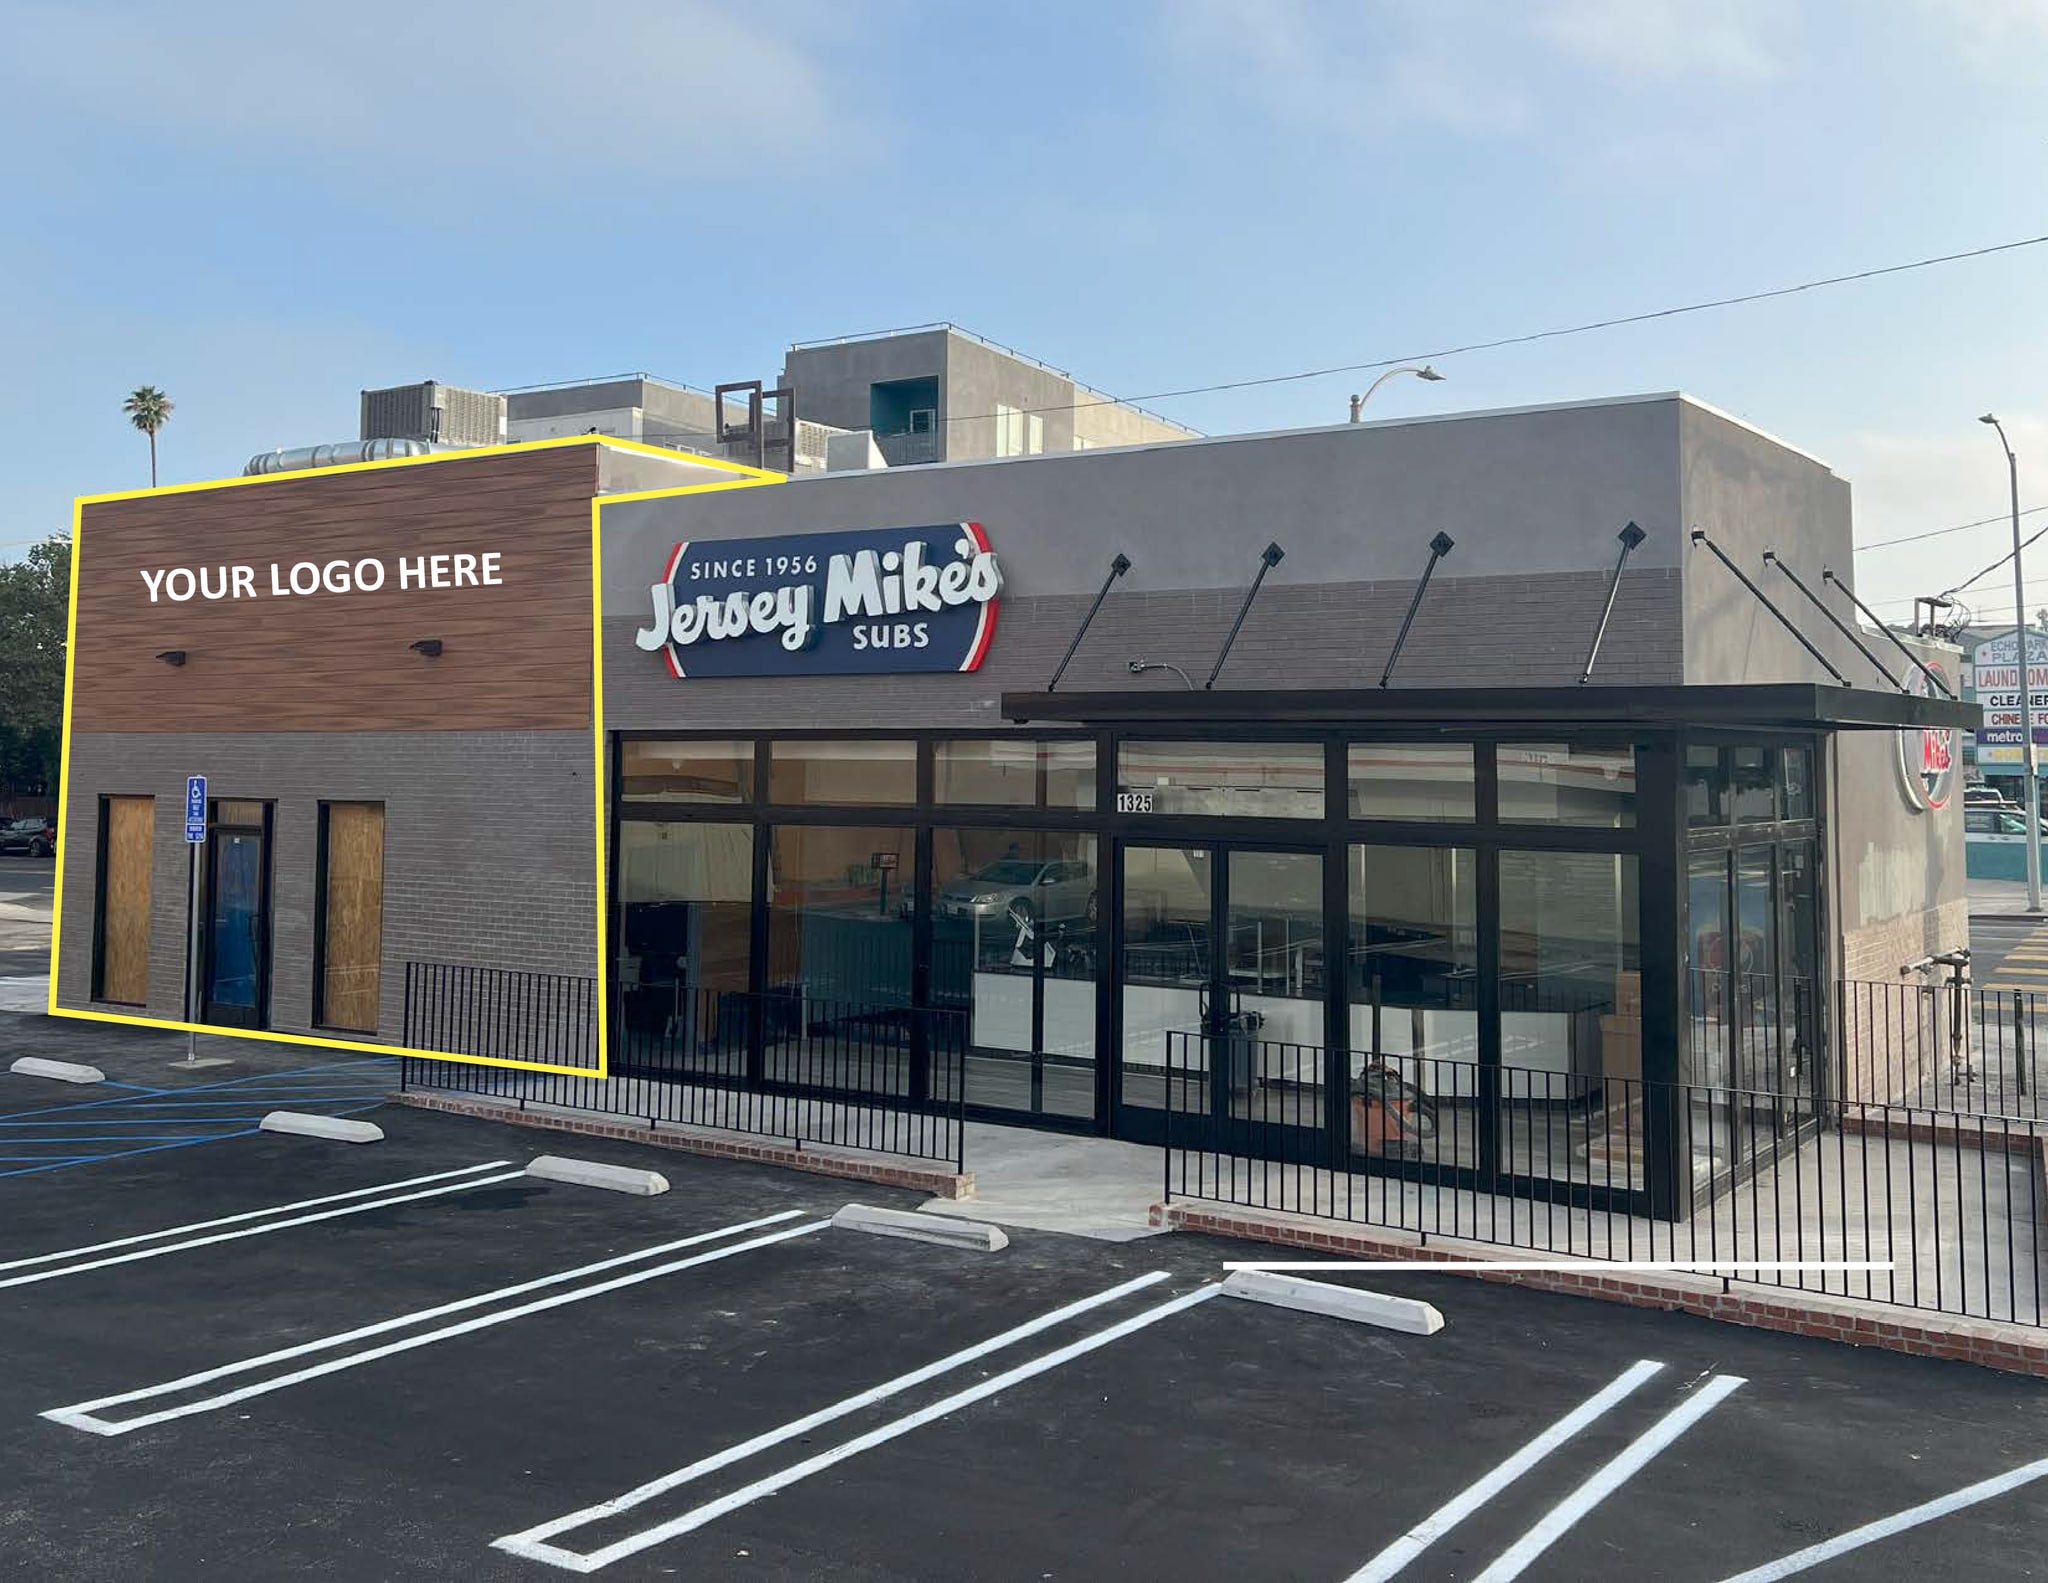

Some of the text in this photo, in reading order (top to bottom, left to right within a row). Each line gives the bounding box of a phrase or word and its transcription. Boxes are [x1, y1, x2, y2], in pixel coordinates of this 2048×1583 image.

[690, 555, 818, 580] SINCE 1956
[635, 538, 1003, 651] Jersey Mike's
[853, 622, 930, 650] SUBS
[1978, 669, 2048, 687] LAUNDOM
[1987, 730, 2023, 742] metro
[1119, 794, 1151, 812] 1325
